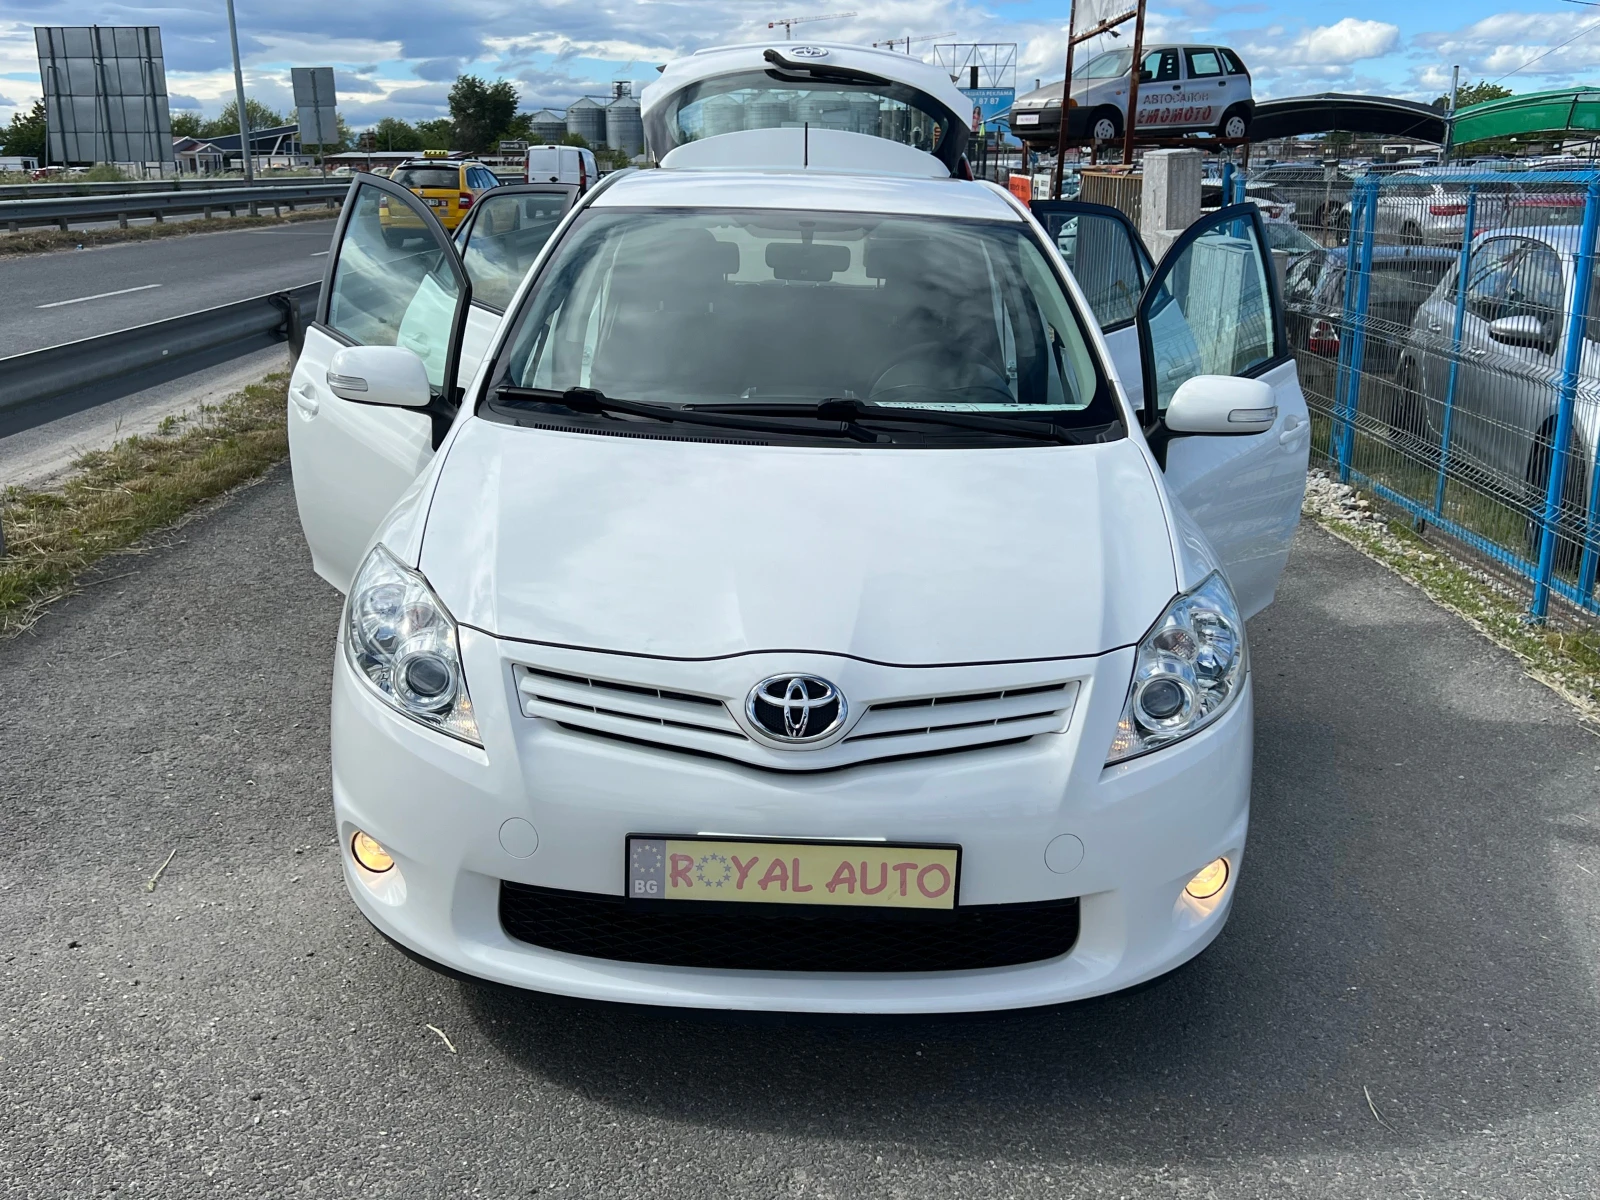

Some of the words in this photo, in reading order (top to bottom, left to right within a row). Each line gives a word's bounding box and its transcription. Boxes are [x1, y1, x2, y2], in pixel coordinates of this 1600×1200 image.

[1143, 92, 1209, 105] АВТОСАЛОН
[826, 860, 951, 899] AUTO
[634, 880, 658, 894] BG
